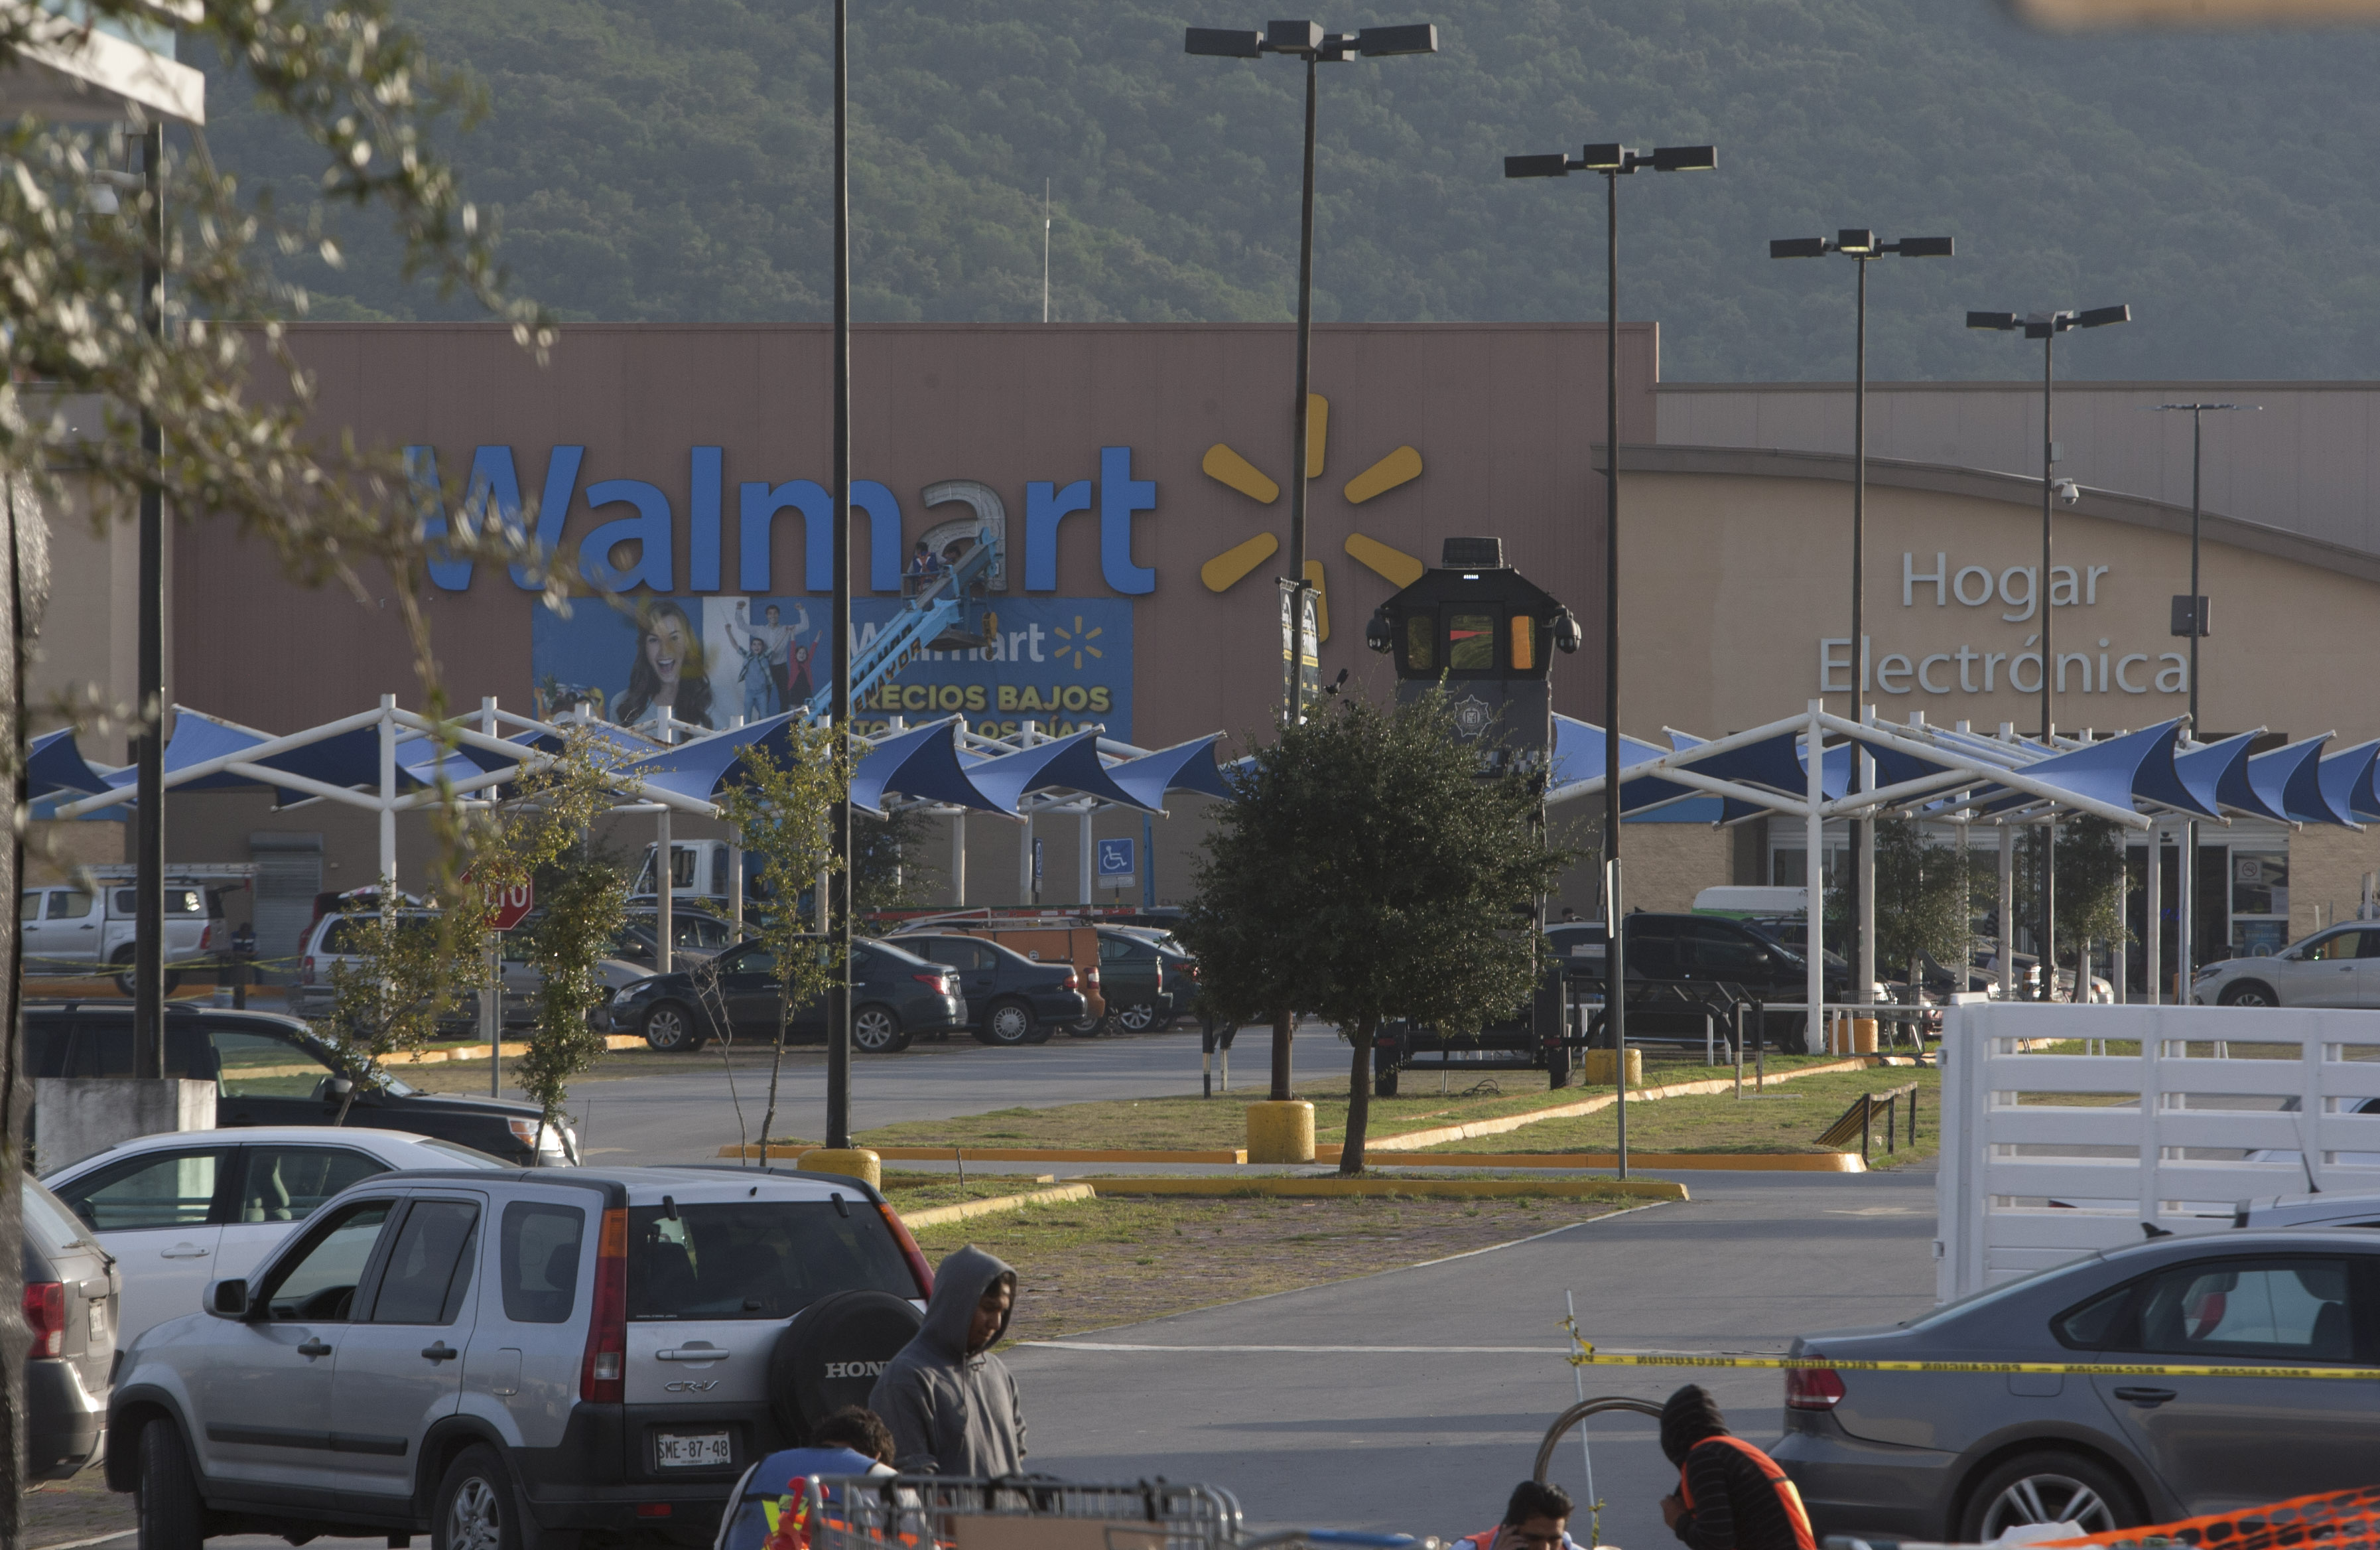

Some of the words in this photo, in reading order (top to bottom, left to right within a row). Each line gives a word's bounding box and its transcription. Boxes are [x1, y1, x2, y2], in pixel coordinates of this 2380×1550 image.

[403, 445, 1156, 595] Walmart
[1902, 551, 2109, 622] Hogar
[850, 622, 1045, 662] Wart
[852, 636, 921, 713] EMAYOR
[1819, 634, 2188, 694] Electrónica
[868, 684, 986, 711] ECIOS
[998, 685, 1110, 712] BAJOS
[484, 881, 527, 908] LTO
[664, 1379, 720, 1393] CR-V
[825, 1361, 891, 1378] HON
[659, 1440, 728, 1459] SME-87-48
